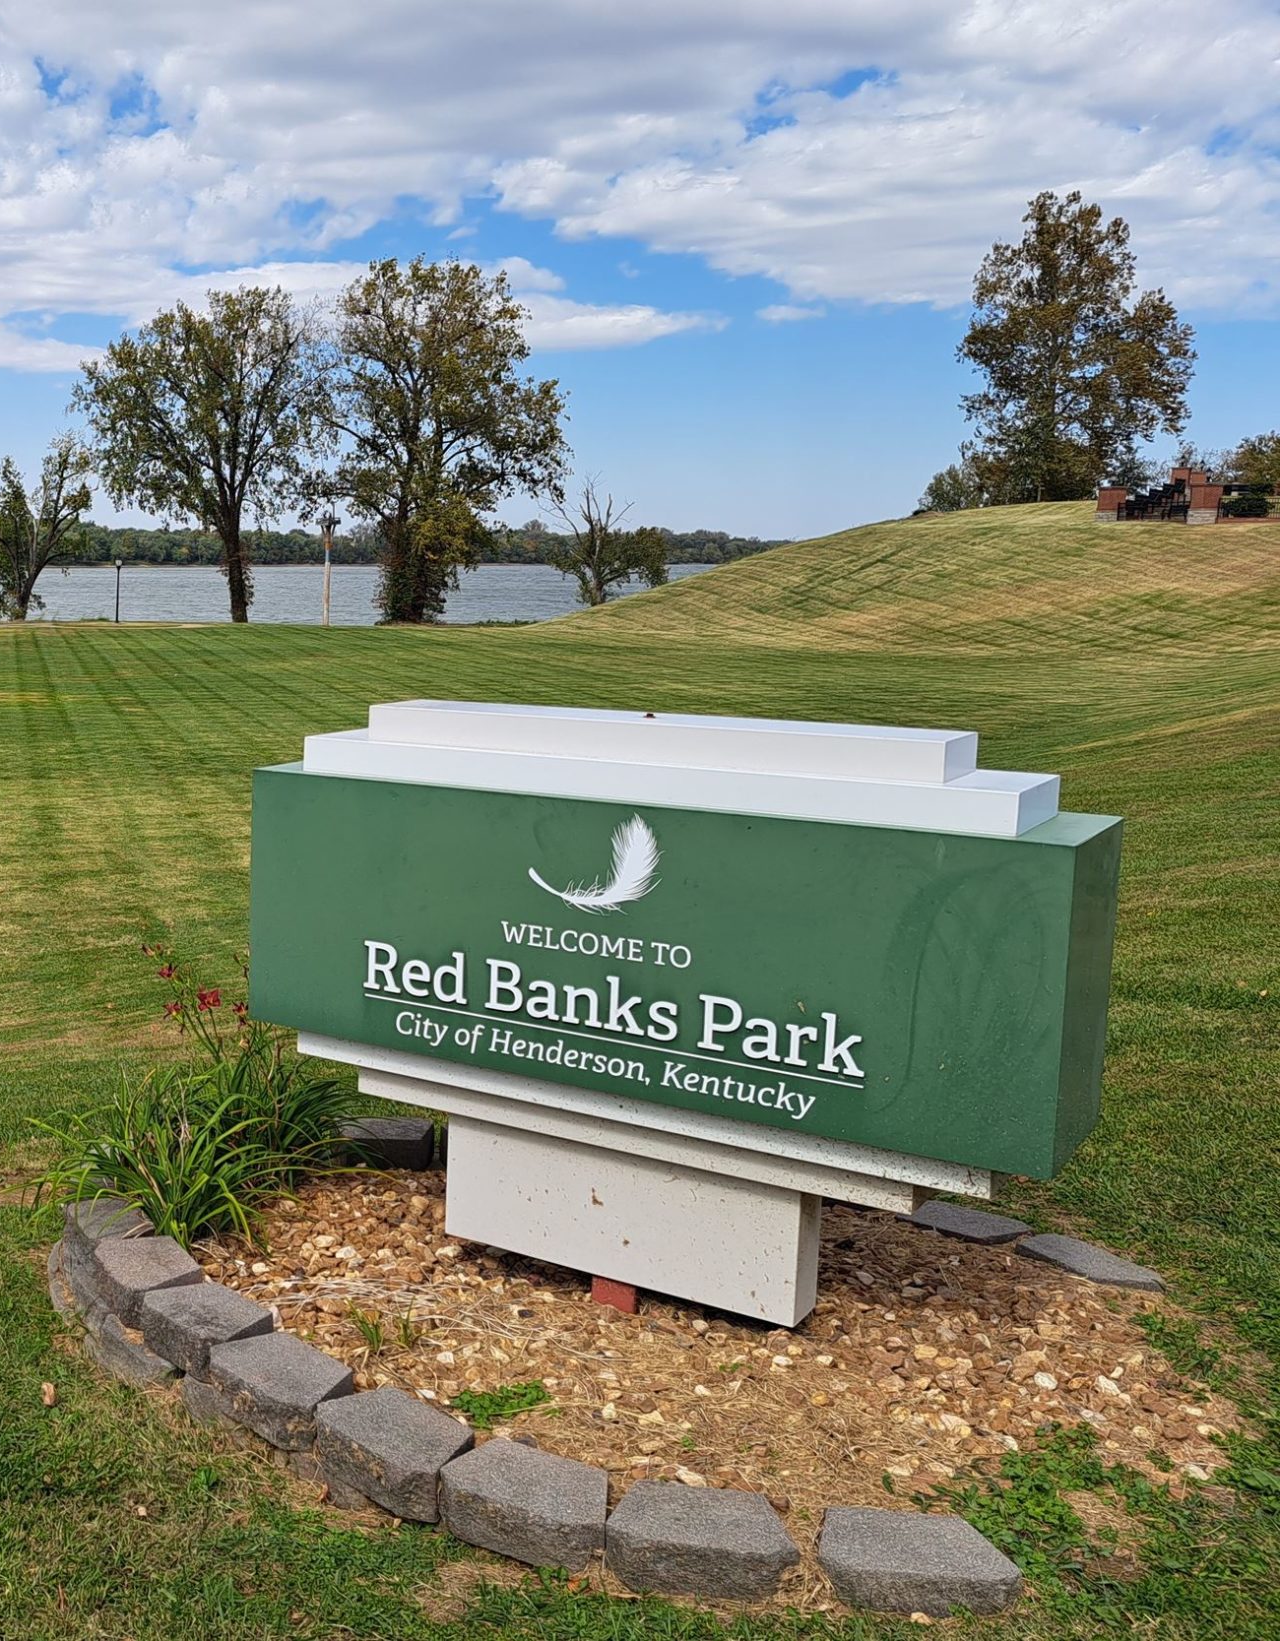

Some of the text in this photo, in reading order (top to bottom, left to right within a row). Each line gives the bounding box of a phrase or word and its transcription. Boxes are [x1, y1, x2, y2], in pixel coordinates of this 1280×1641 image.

[501, 920, 692, 969] WELCOME TO
[362, 939, 865, 1078] Red Banks Park
[395, 1011, 816, 1120] City of Henderson, Kentucky
